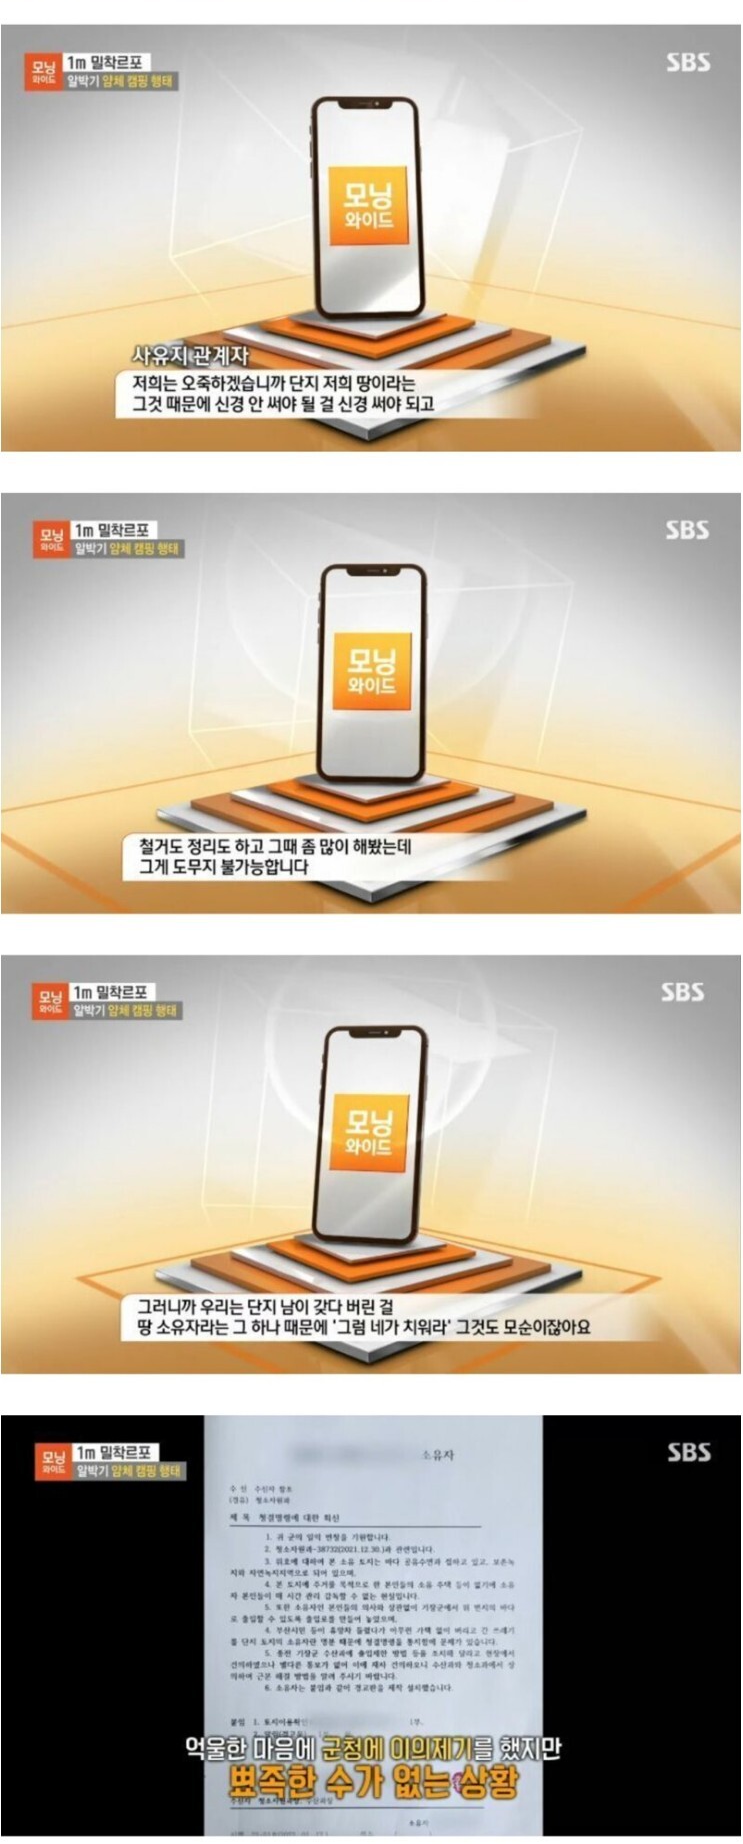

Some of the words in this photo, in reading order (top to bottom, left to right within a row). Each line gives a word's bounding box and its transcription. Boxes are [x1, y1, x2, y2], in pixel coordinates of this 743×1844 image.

[344, 182, 393, 210] 모닝
[345, 212, 394, 229] 와이드
[422, 1449, 454, 1461] 소유자
